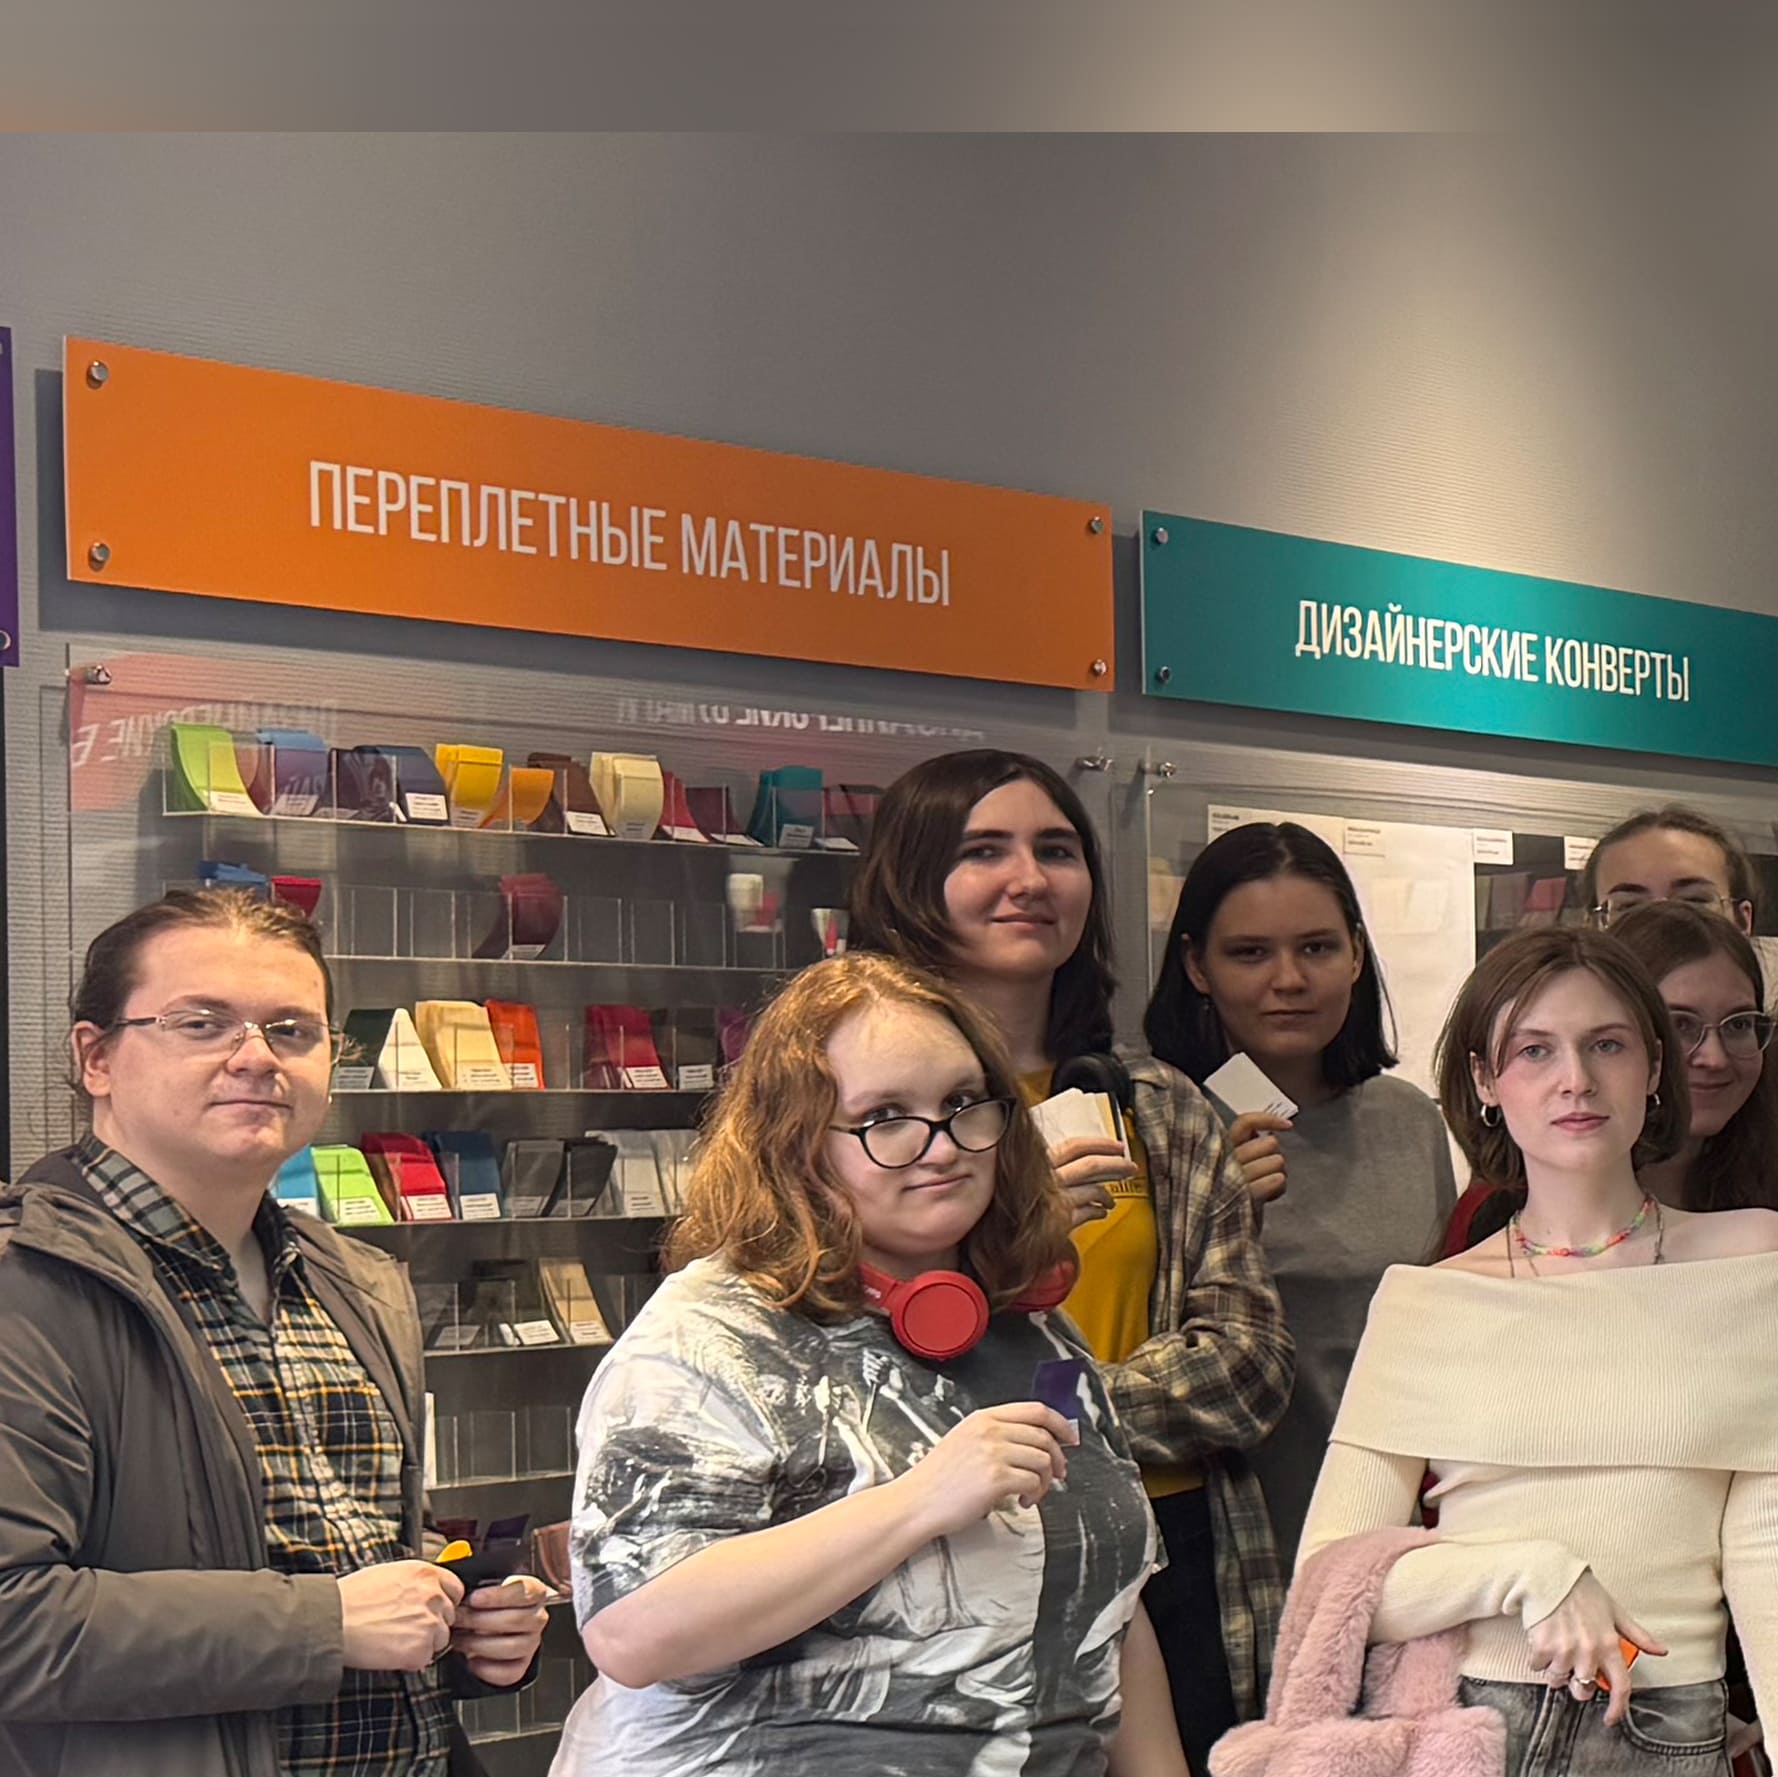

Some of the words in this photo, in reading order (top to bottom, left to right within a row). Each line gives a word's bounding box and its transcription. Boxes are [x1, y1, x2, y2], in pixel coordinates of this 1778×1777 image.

[309, 460, 667, 571] ПЕРЕПЛЕТНЫЕ
[681, 514, 951, 606] МАТЕРИАЛЫ
[1294, 599, 1538, 684] ДИЗАЙНЕРСКИЕ
[1545, 634, 1690, 702] КОНВЕРТЫ
